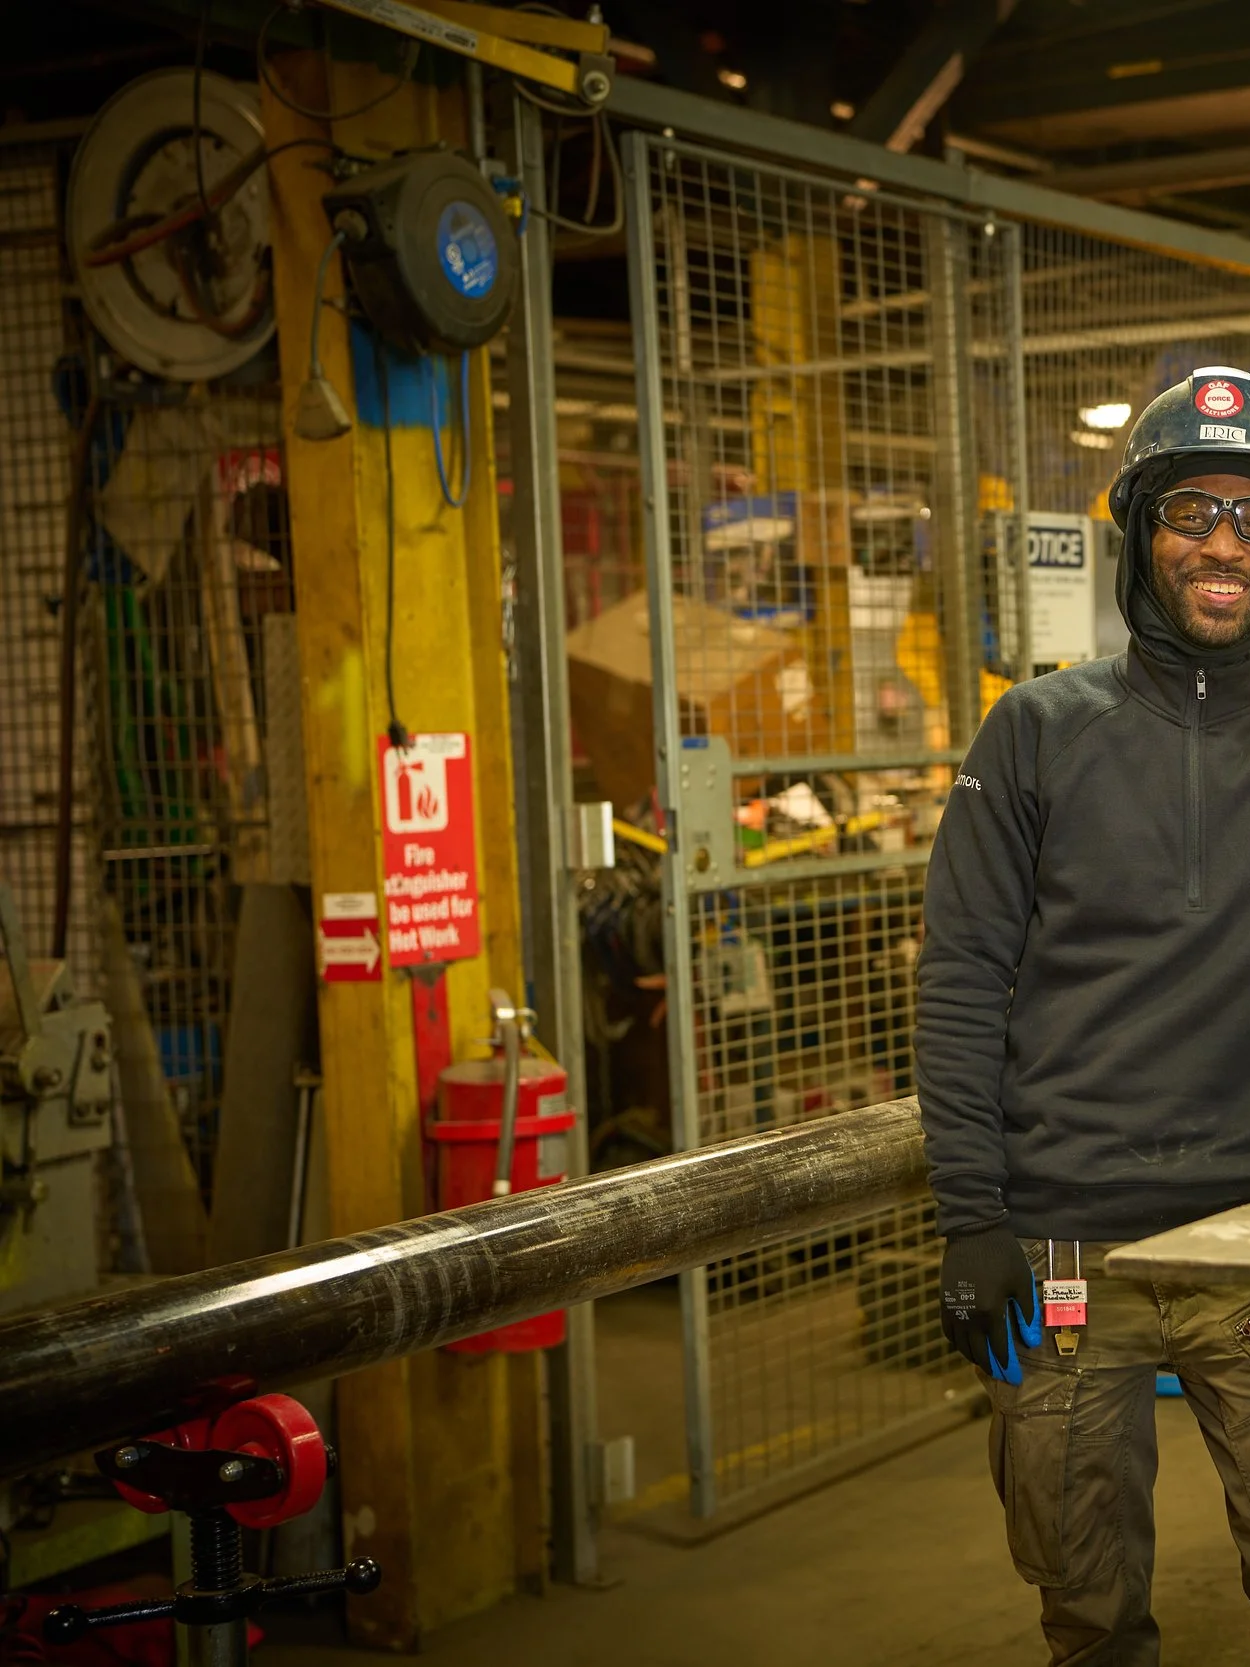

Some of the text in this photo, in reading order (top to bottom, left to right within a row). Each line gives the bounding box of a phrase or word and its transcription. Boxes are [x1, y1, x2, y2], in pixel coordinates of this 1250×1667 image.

[1208, 381, 1230, 390] GAF
[1200, 405, 1240, 416] BALTIMORE
[1204, 426, 1243, 441] ERIC
[1022, 530, 1082, 565] OTICE
[404, 843, 435, 868] Fire
[389, 901, 410, 925] be
[411, 896, 449, 923] used
[450, 894, 474, 918] for
